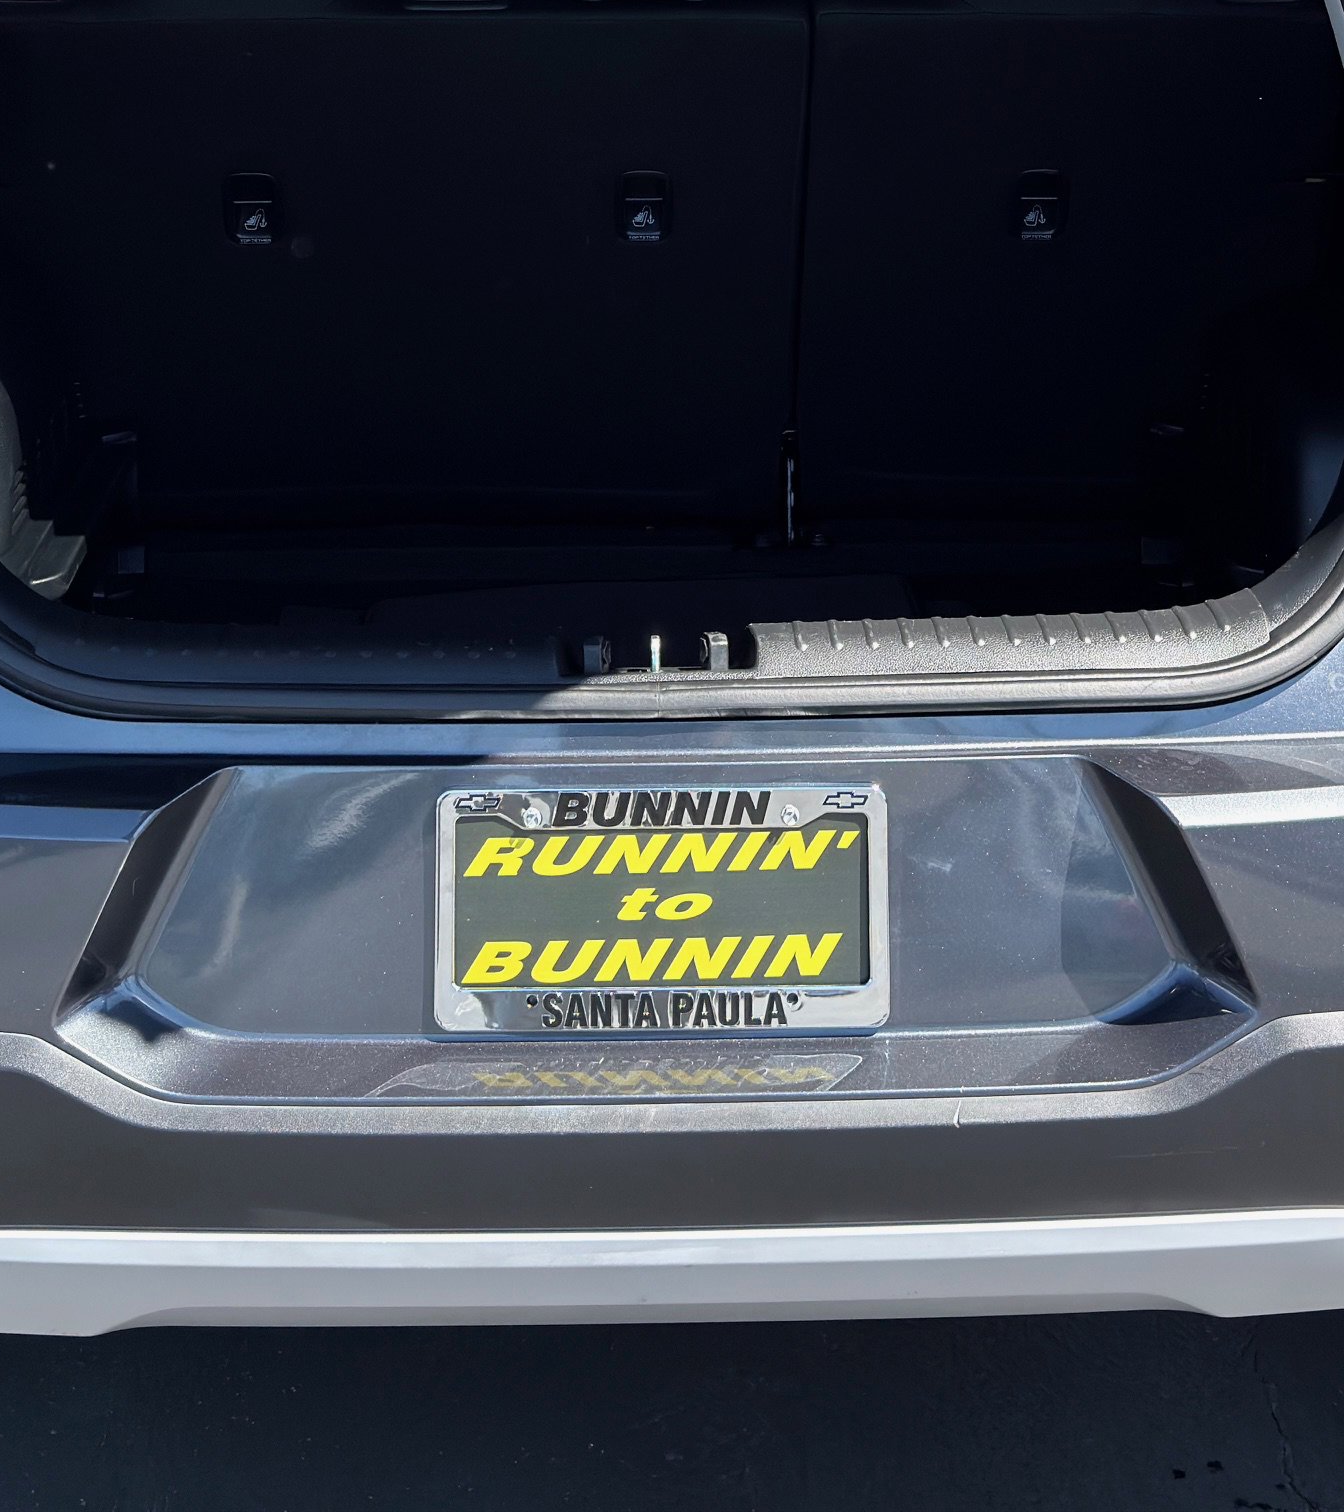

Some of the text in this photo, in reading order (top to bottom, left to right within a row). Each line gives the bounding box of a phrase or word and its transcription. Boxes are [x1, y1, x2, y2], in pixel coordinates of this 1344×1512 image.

[552, 791, 771, 827] BUNNIN
[463, 829, 860, 877] RUNNIN'
[617, 888, 713, 921] to
[461, 933, 843, 984] BUNNIN
[542, 991, 787, 1028] SANTA PAULA
